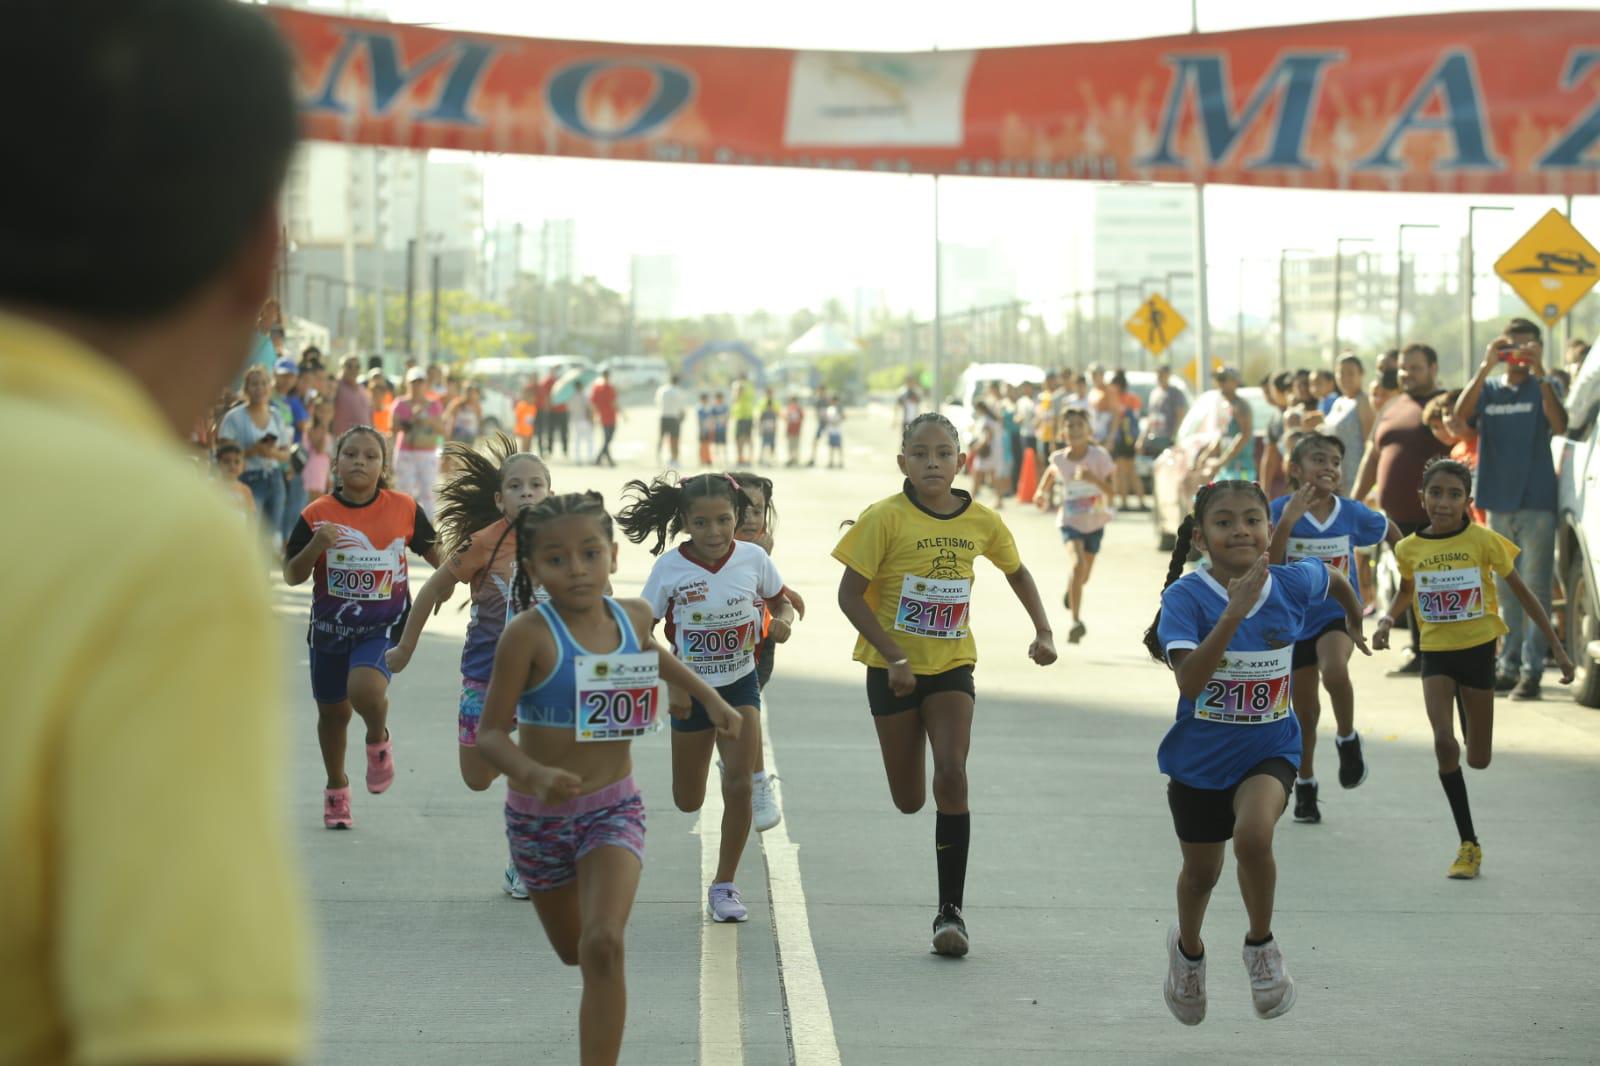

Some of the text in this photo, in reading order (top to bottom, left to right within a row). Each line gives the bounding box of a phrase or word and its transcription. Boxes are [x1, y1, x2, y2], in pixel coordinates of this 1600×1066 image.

[916, 537, 975, 551] ATLETISMO
[1418, 552, 1470, 569] ATLETISMO
[331, 570, 376, 592] 209
[1421, 592, 1462, 613] 212
[903, 601, 953, 629] 211
[687, 629, 739, 653] 206
[1204, 681, 1270, 711] 218
[585, 690, 653, 726] 201
